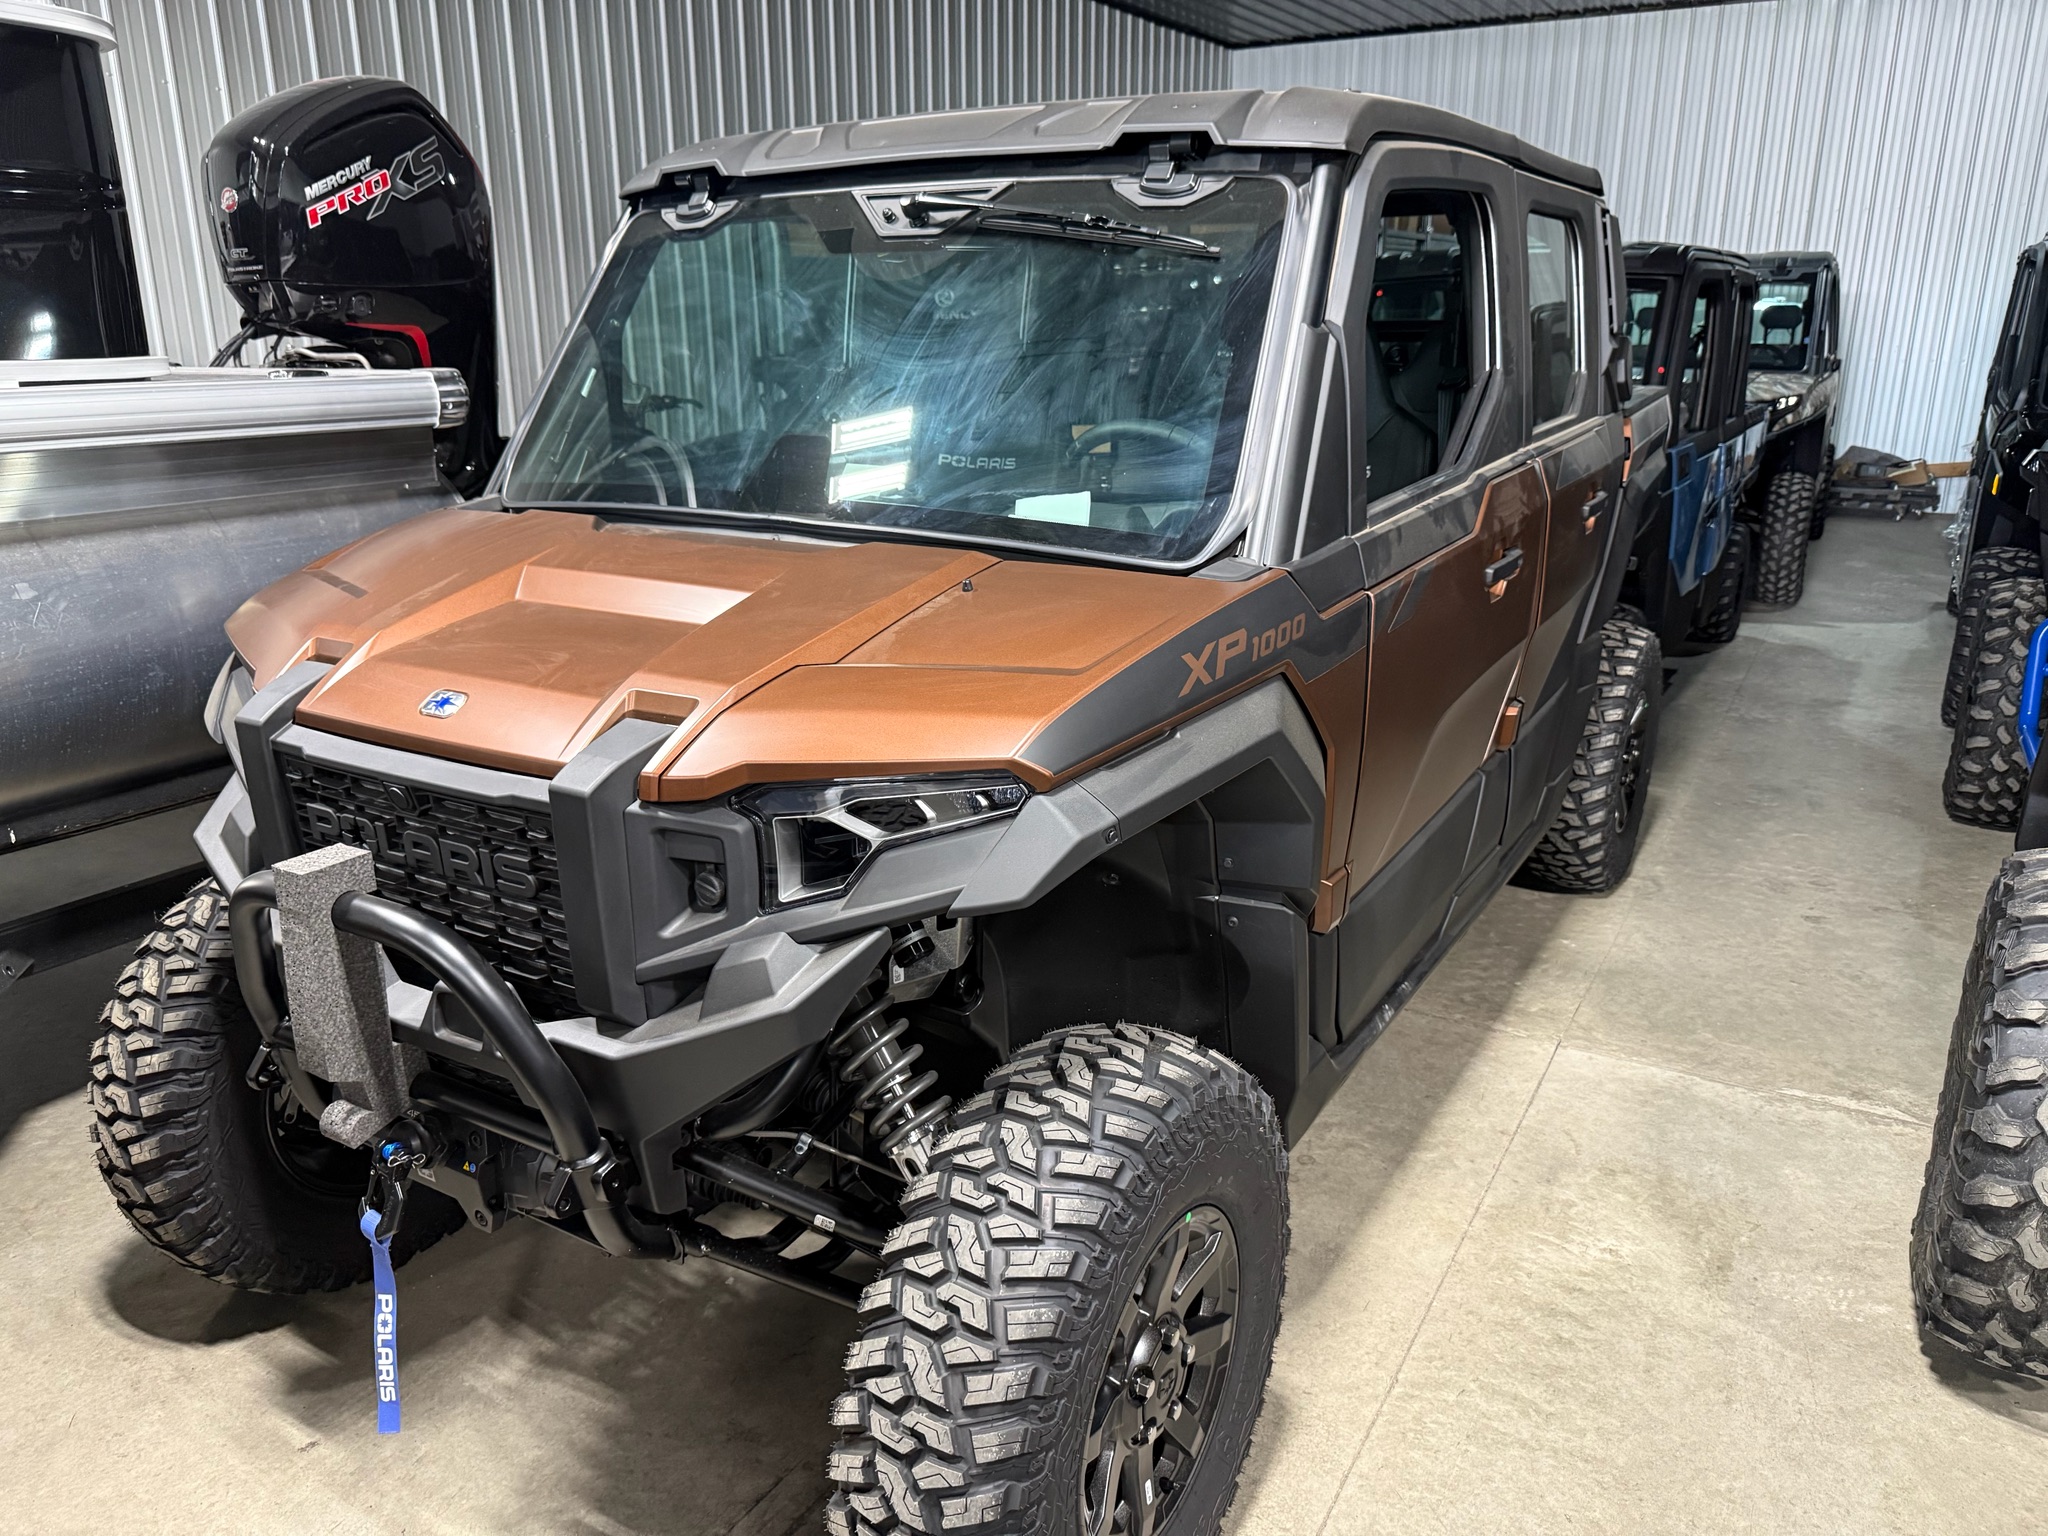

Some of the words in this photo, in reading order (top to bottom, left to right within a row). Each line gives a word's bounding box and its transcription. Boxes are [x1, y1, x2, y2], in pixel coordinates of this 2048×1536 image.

[304, 155, 372, 201] MERCURY
[305, 169, 392, 229] PRO
[361, 135, 446, 221] XS
[938, 453, 1016, 469] POLARIS
[1178, 627, 1248, 698] XP
[1251, 612, 1306, 662] 1000
[377, 1293, 396, 1402] POLARIS
